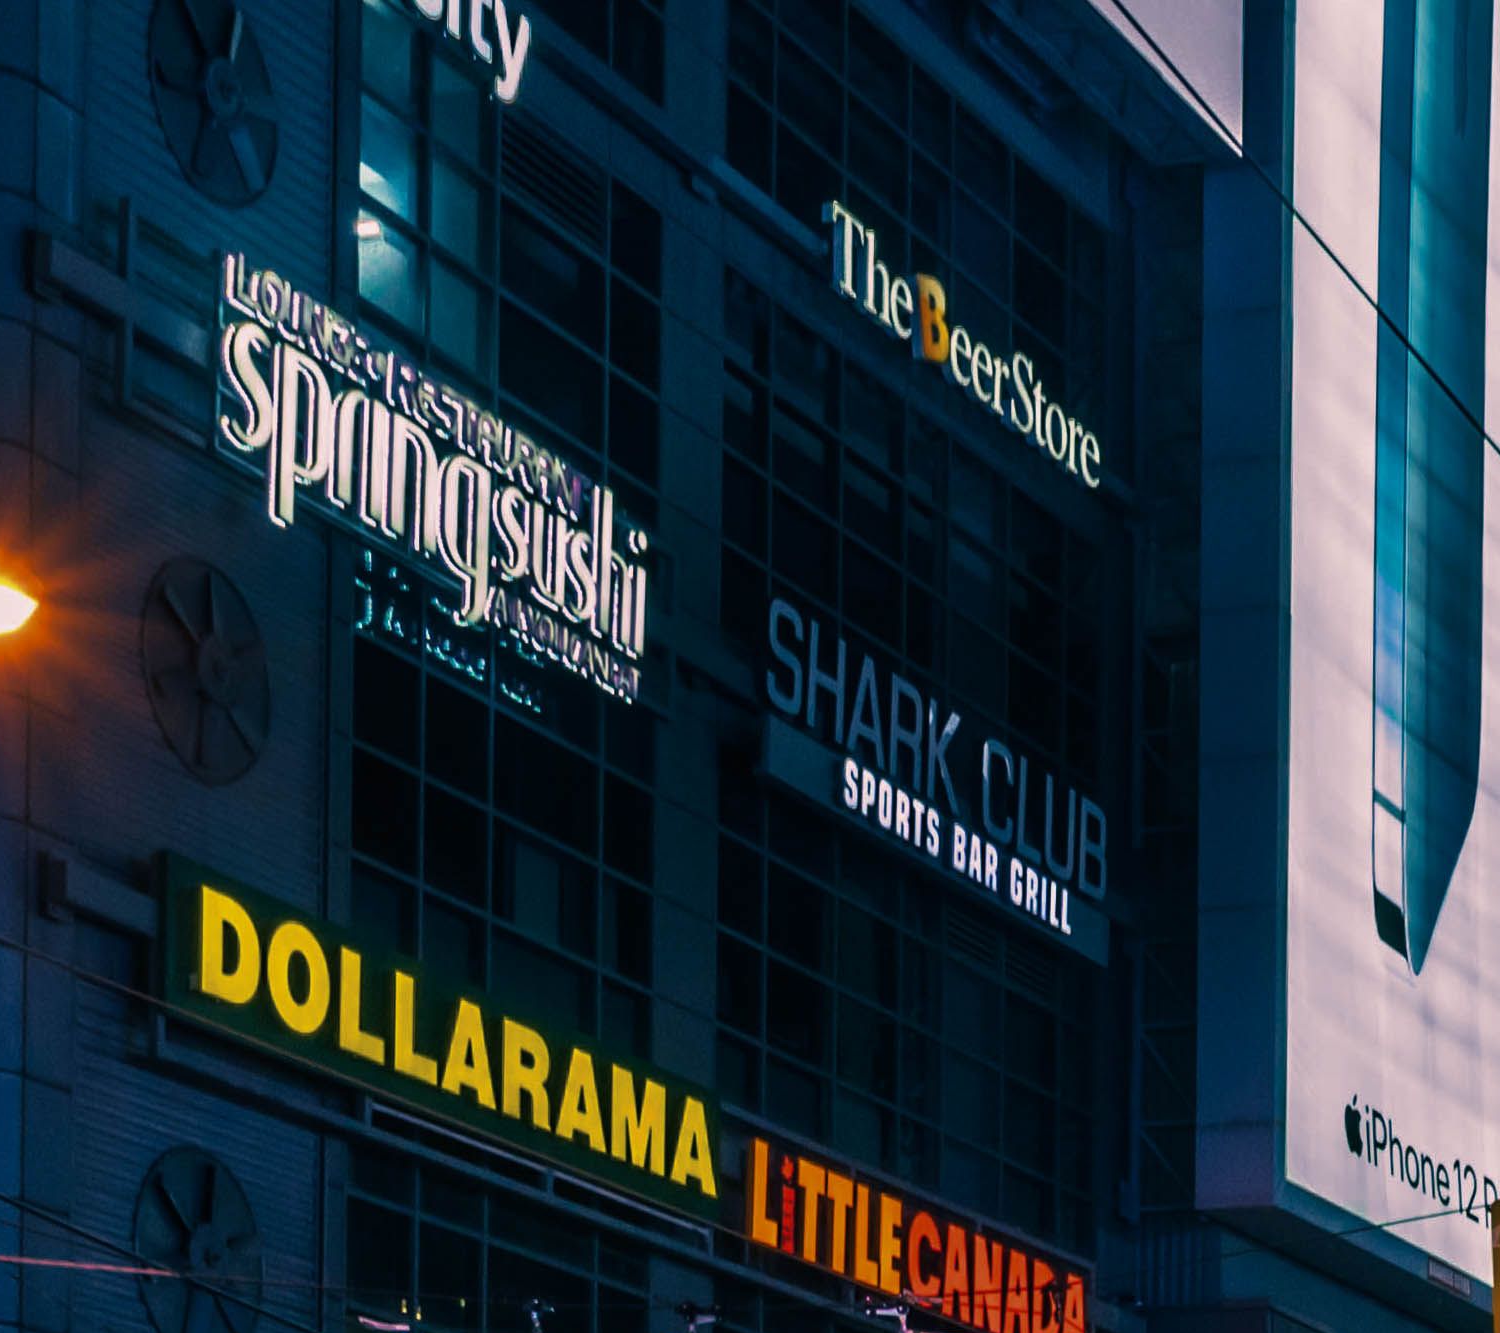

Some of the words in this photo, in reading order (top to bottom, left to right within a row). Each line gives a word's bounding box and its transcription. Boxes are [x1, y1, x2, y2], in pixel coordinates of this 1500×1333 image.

[832, 200, 914, 339] The
[915, 273, 1010, 417] Beer
[1011, 352, 1101, 489] Store
[766, 597, 961, 815] SHARK
[982, 738, 1108, 900] CLUB
[843, 756, 940, 858] SPORTS
[952, 822, 999, 892] BAR
[1009, 856, 1072, 936] GRILL
[197, 883, 719, 1199] DOLLARAMA
[1365, 1104, 1451, 1207] iPhone
[1453, 1158, 1480, 1224] 12
